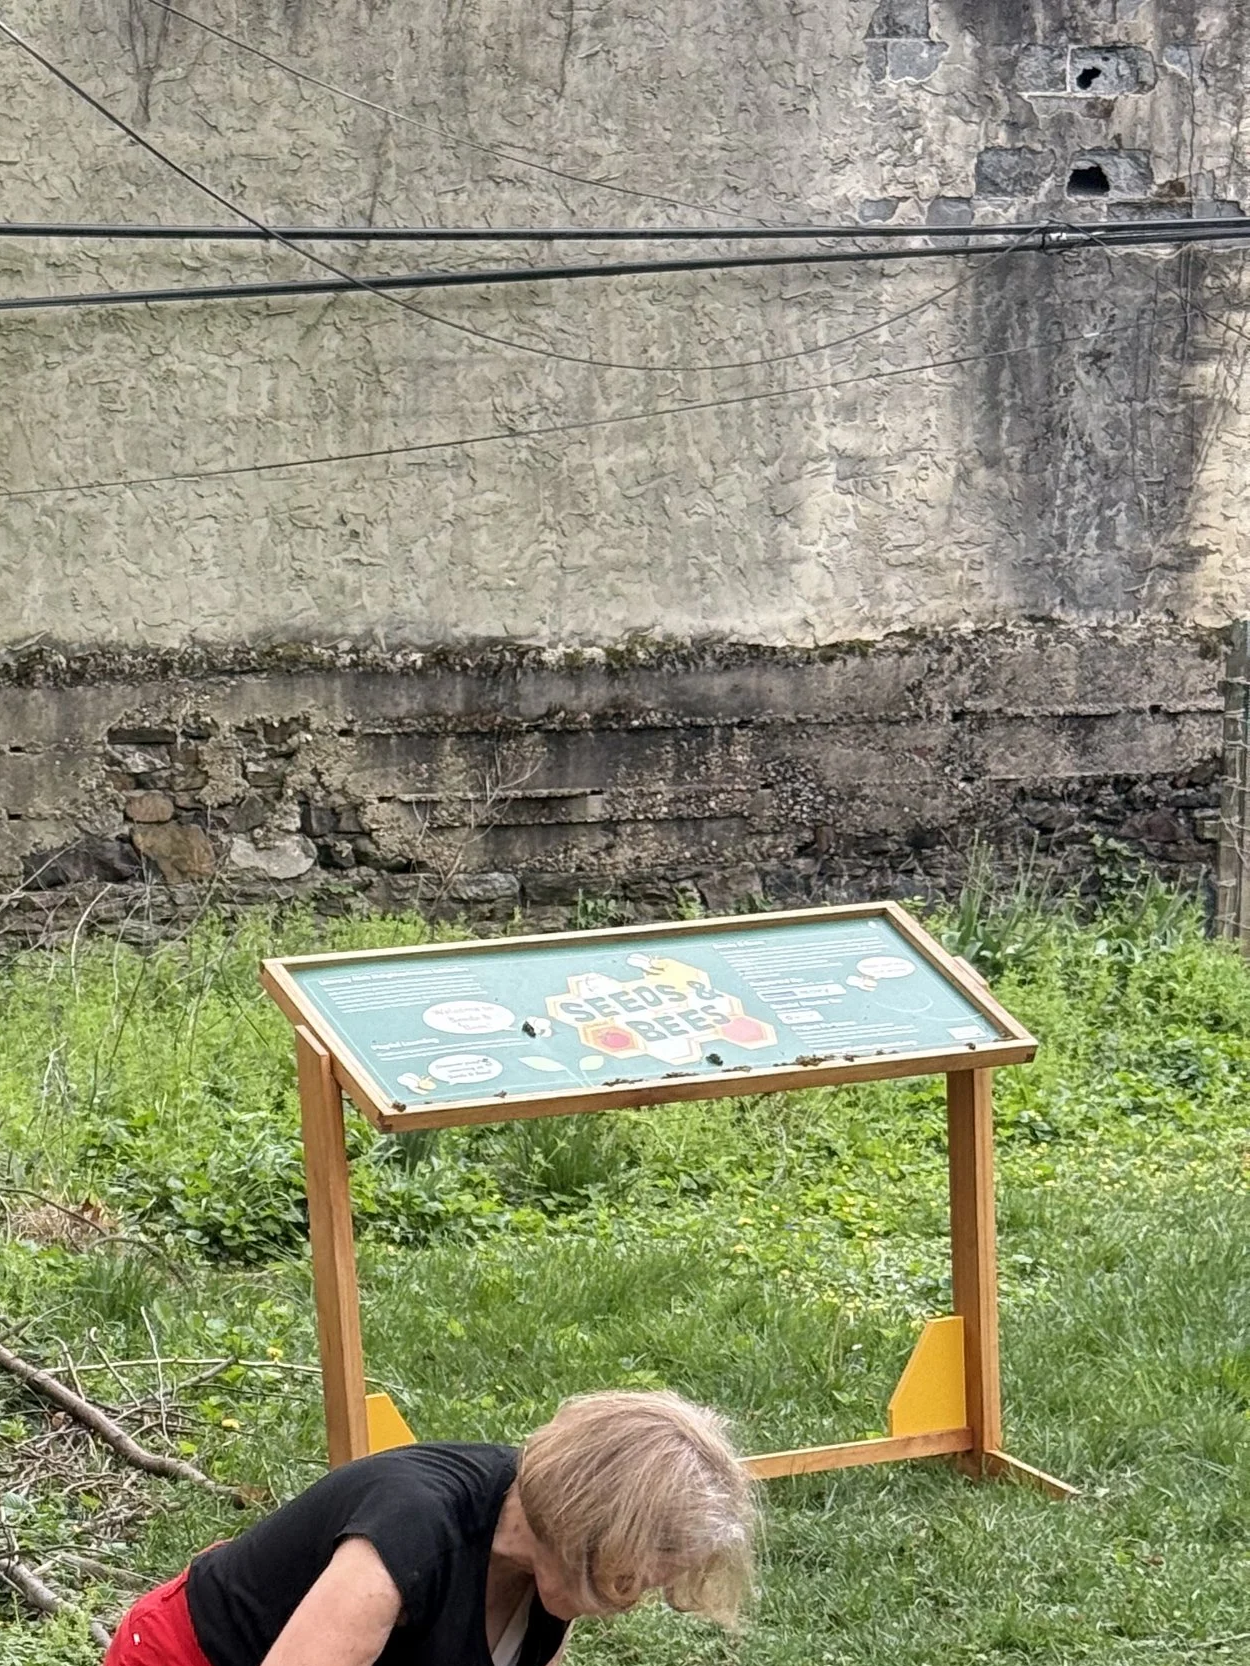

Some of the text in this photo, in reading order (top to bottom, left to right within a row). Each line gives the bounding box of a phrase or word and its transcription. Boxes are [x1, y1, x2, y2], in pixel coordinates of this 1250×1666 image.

[559, 980, 724, 1023] SEEDS &
[625, 1004, 731, 1042] BEES
